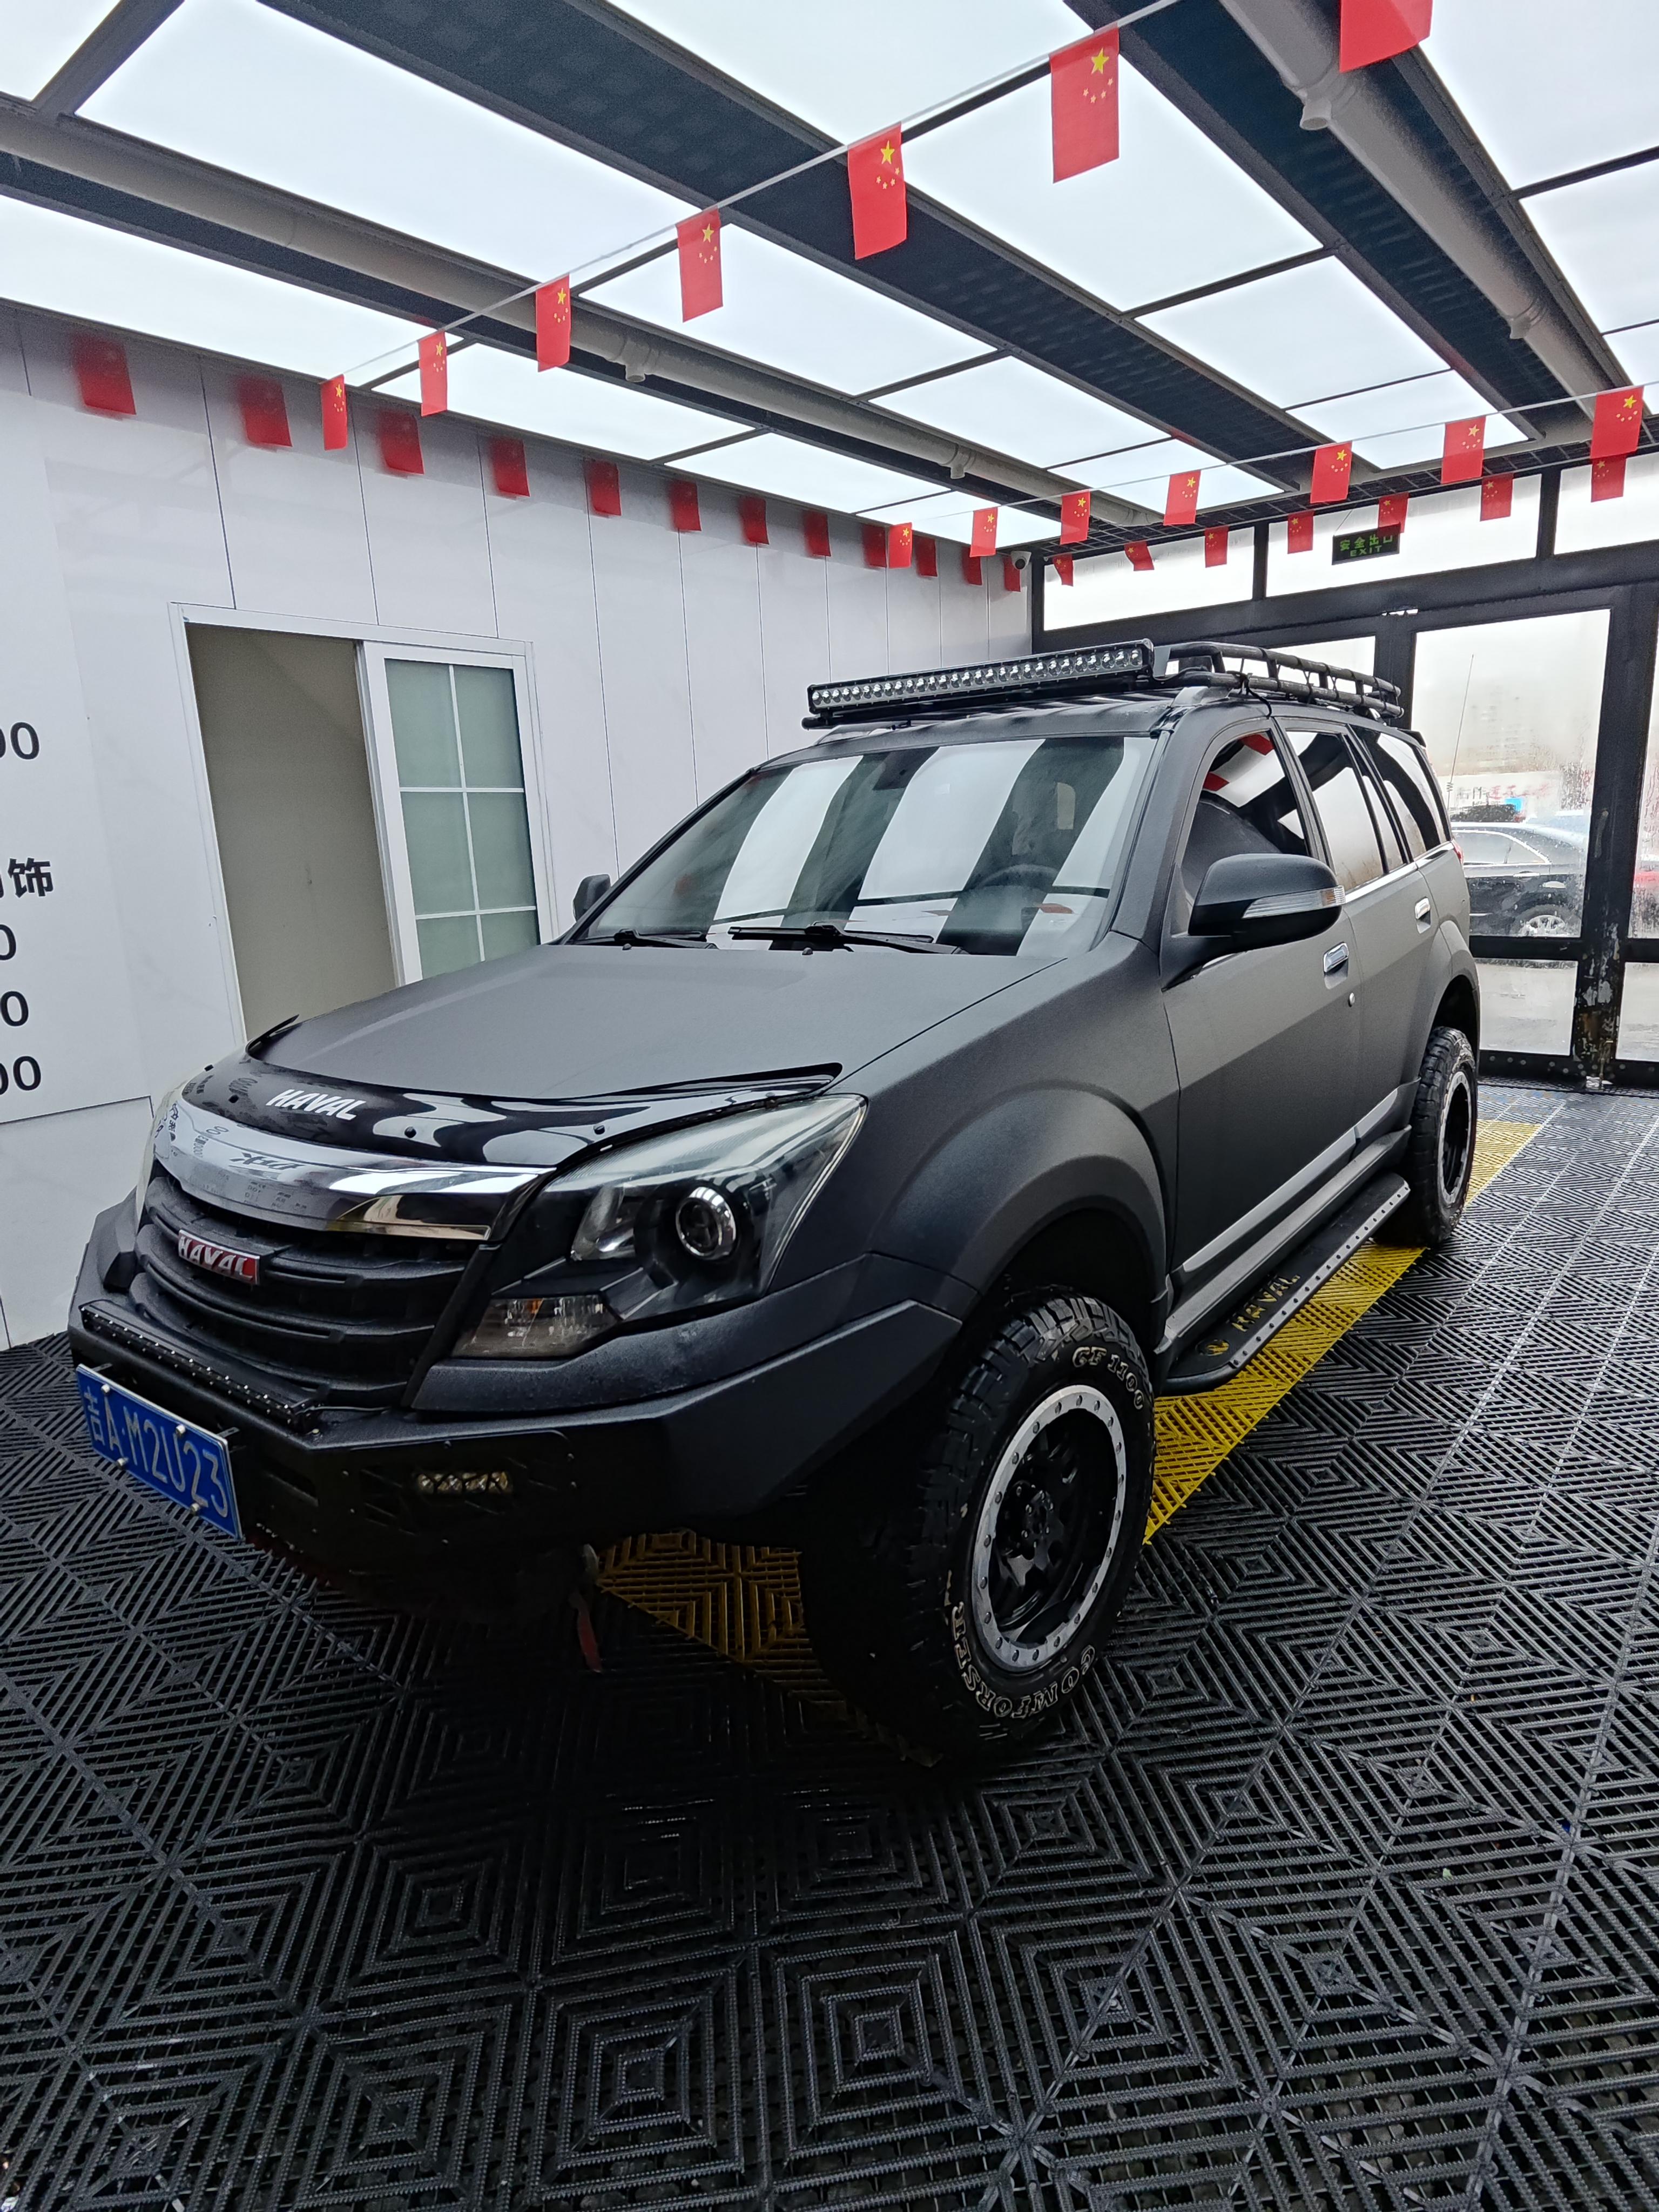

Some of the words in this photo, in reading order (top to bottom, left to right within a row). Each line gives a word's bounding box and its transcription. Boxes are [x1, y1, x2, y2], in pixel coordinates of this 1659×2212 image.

[1340, 533, 1393, 551] 安全出口
[1351, 545, 1382, 557] EXIT
[0, 721, 40, 760] 0
[0, 857, 53, 898] 饰
[266, 1089, 367, 1121] HAVAL
[178, 1235, 253, 1282] HAVAL
[1226, 1274, 1301, 1332] HAVAL
[1072, 1346, 1108, 1367] CF
[1107, 1353, 1144, 1410] 1100
[952, 1601, 1096, 1719] COMFORSER
